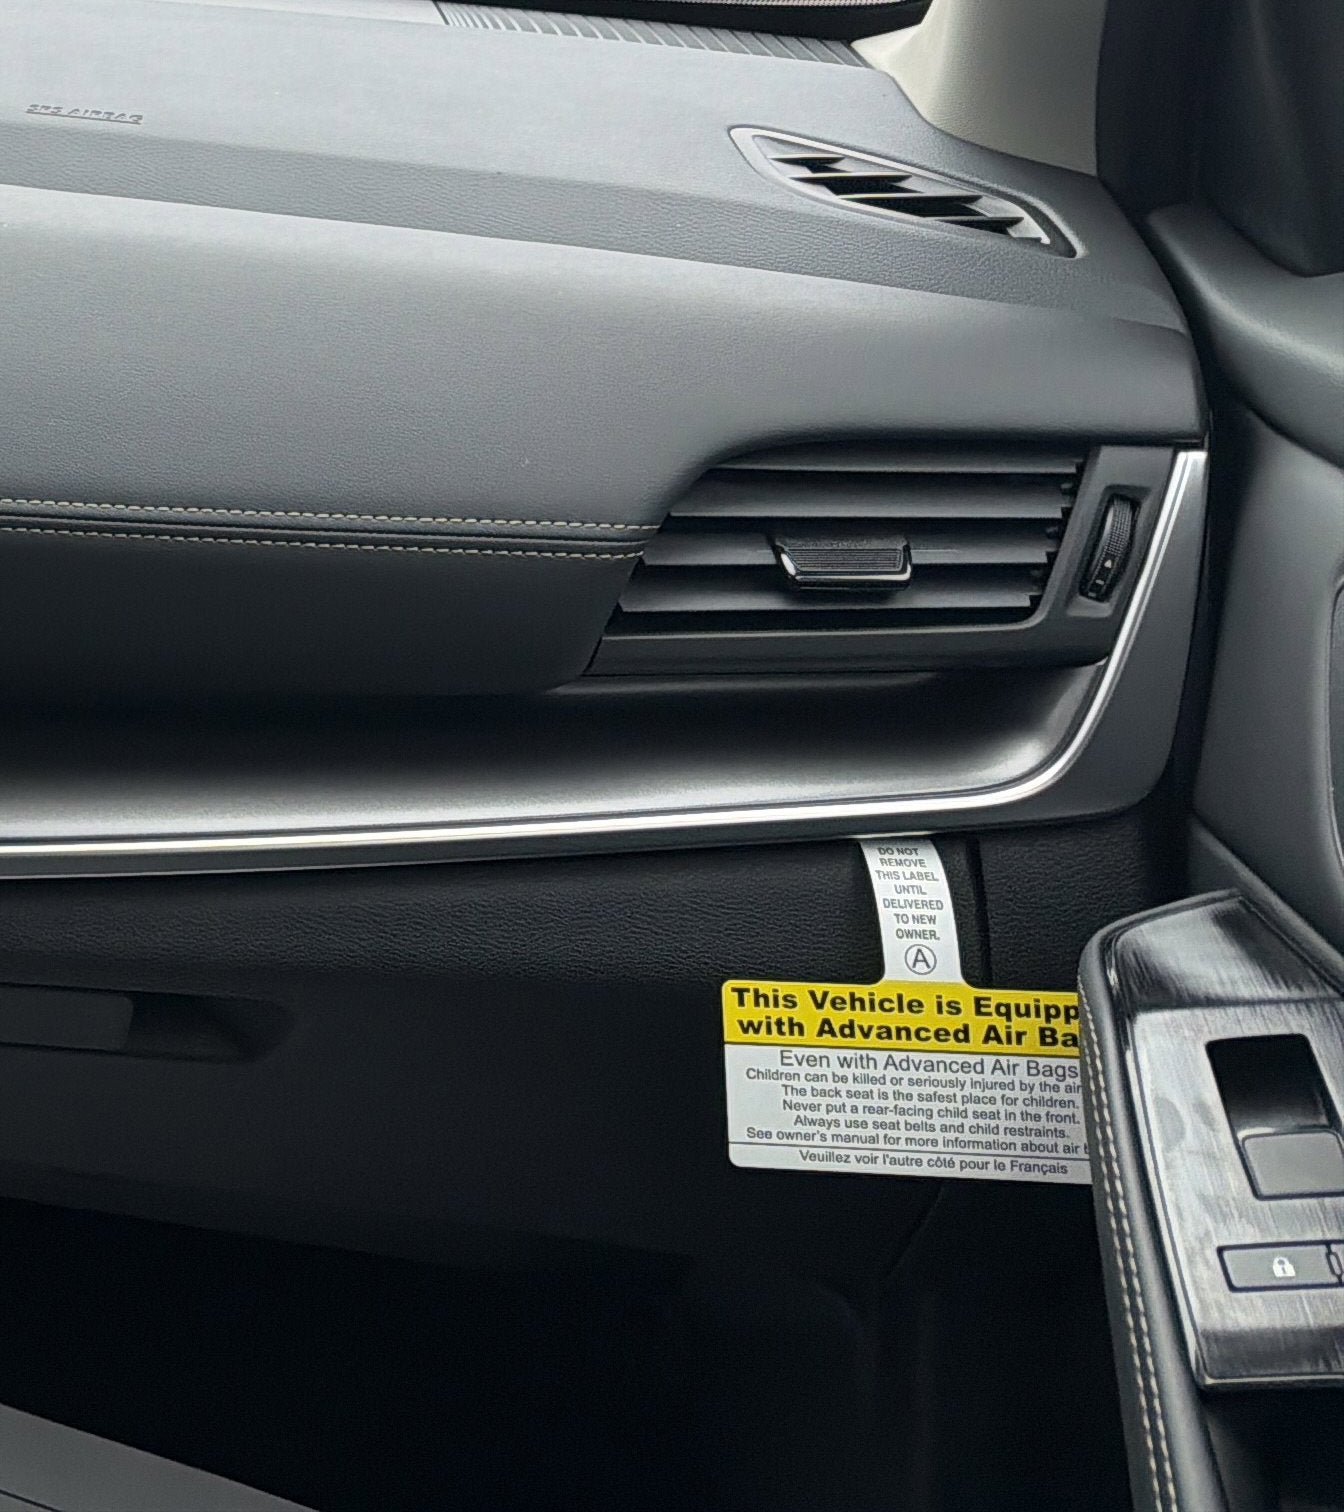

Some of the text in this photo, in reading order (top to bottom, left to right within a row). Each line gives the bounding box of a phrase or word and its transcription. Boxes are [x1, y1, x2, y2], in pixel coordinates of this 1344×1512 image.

[877, 847, 919, 856] DO NOT
[879, 858, 927, 868] REMOVE
[875, 870, 939, 881] THIS LABEL
[894, 884, 927, 895] UNTIL
[882, 898, 944, 911] DELIVERED
[893, 913, 936, 925] TO NEW
[895, 928, 940, 941] OWNER.
[731, 987, 1079, 1025] This Vehicle is Equipp
[737, 1016, 1027, 1046] with Advanced Air
[780, 1050, 1079, 1082] Even with Advanced Air Bags
[746, 1067, 1082, 1094] Children can be killed or seriously injured by the air
[782, 1084, 1079, 1109] The back seat is the safest place for children.
[783, 1099, 1080, 1124] Never put a rear-facing child seat in the front.
[794, 1114, 1070, 1138] Always use seat belts and child restraints.
[746, 1127, 772, 1139] See
[776, 1130, 827, 1142] owner's
[831, 1133, 879, 1145] manual
[883, 1133, 901, 1145] for
[905, 1137, 938, 1147] more
[943, 1137, 1016, 1151] information
[1021, 1140, 1058, 1153] about
[1063, 1143, 1080, 1154] air
[799, 1150, 1068, 1175] Veuillez voir l'autre côté pour le Français
